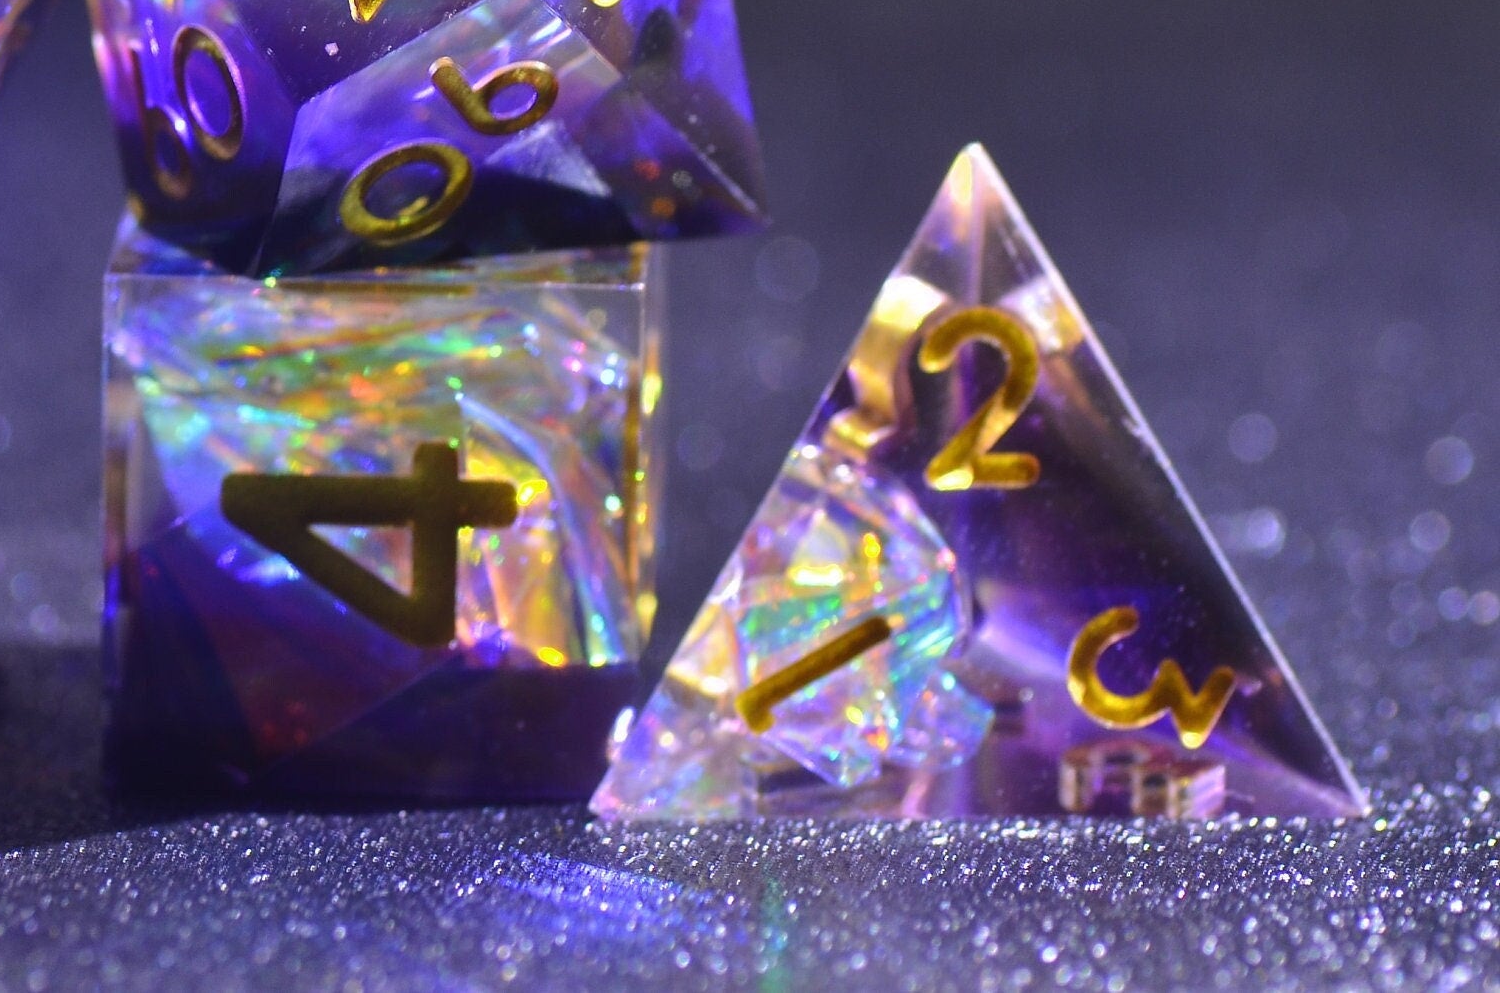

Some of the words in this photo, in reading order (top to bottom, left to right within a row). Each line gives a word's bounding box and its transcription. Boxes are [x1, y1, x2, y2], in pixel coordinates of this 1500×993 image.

[918, 307, 1042, 492] 2
[219, 441, 519, 648] 4
[734, 617, 893, 735] 1
[1067, 606, 1238, 751] 3
